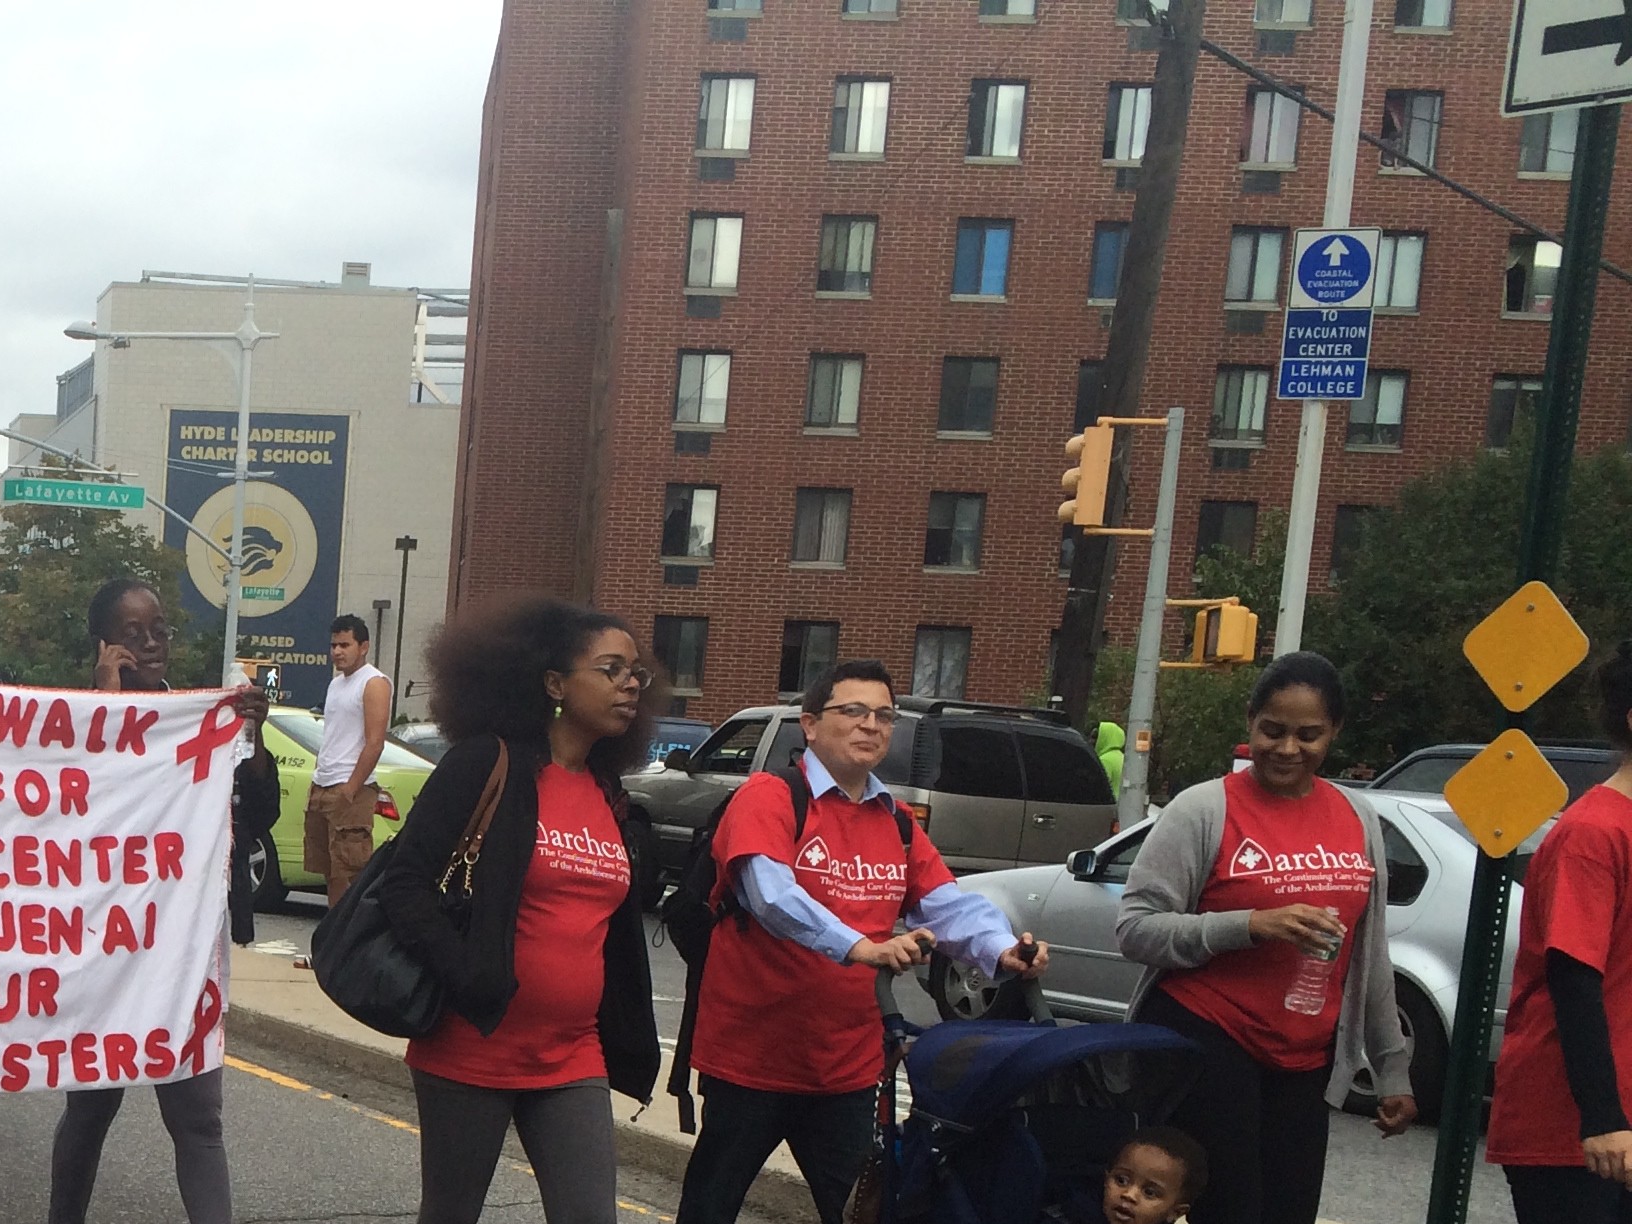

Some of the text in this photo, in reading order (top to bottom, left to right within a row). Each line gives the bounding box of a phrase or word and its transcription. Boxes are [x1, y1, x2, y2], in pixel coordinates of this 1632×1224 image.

[1315, 270, 1353, 278] COASTAL
[1308, 280, 1359, 288] EVACUATION
[1318, 290, 1346, 298] ROUTE
[1321, 309, 1338, 322] TO
[1288, 326, 1367, 339] EVACUATION
[1299, 344, 1353, 356] CENTER
[1290, 364, 1355, 377] LEHMAN
[1288, 381, 1356, 394] COLLEGE
[180, 425, 337, 444] HYDE LADERSHIP
[181, 445, 333, 465] CHARTR SCHOOL
[15, 483, 130, 504] Lafayette Av
[537, 847, 557, 857] The
[831, 854, 908, 881] archcar
[1262, 875, 1282, 885] The
